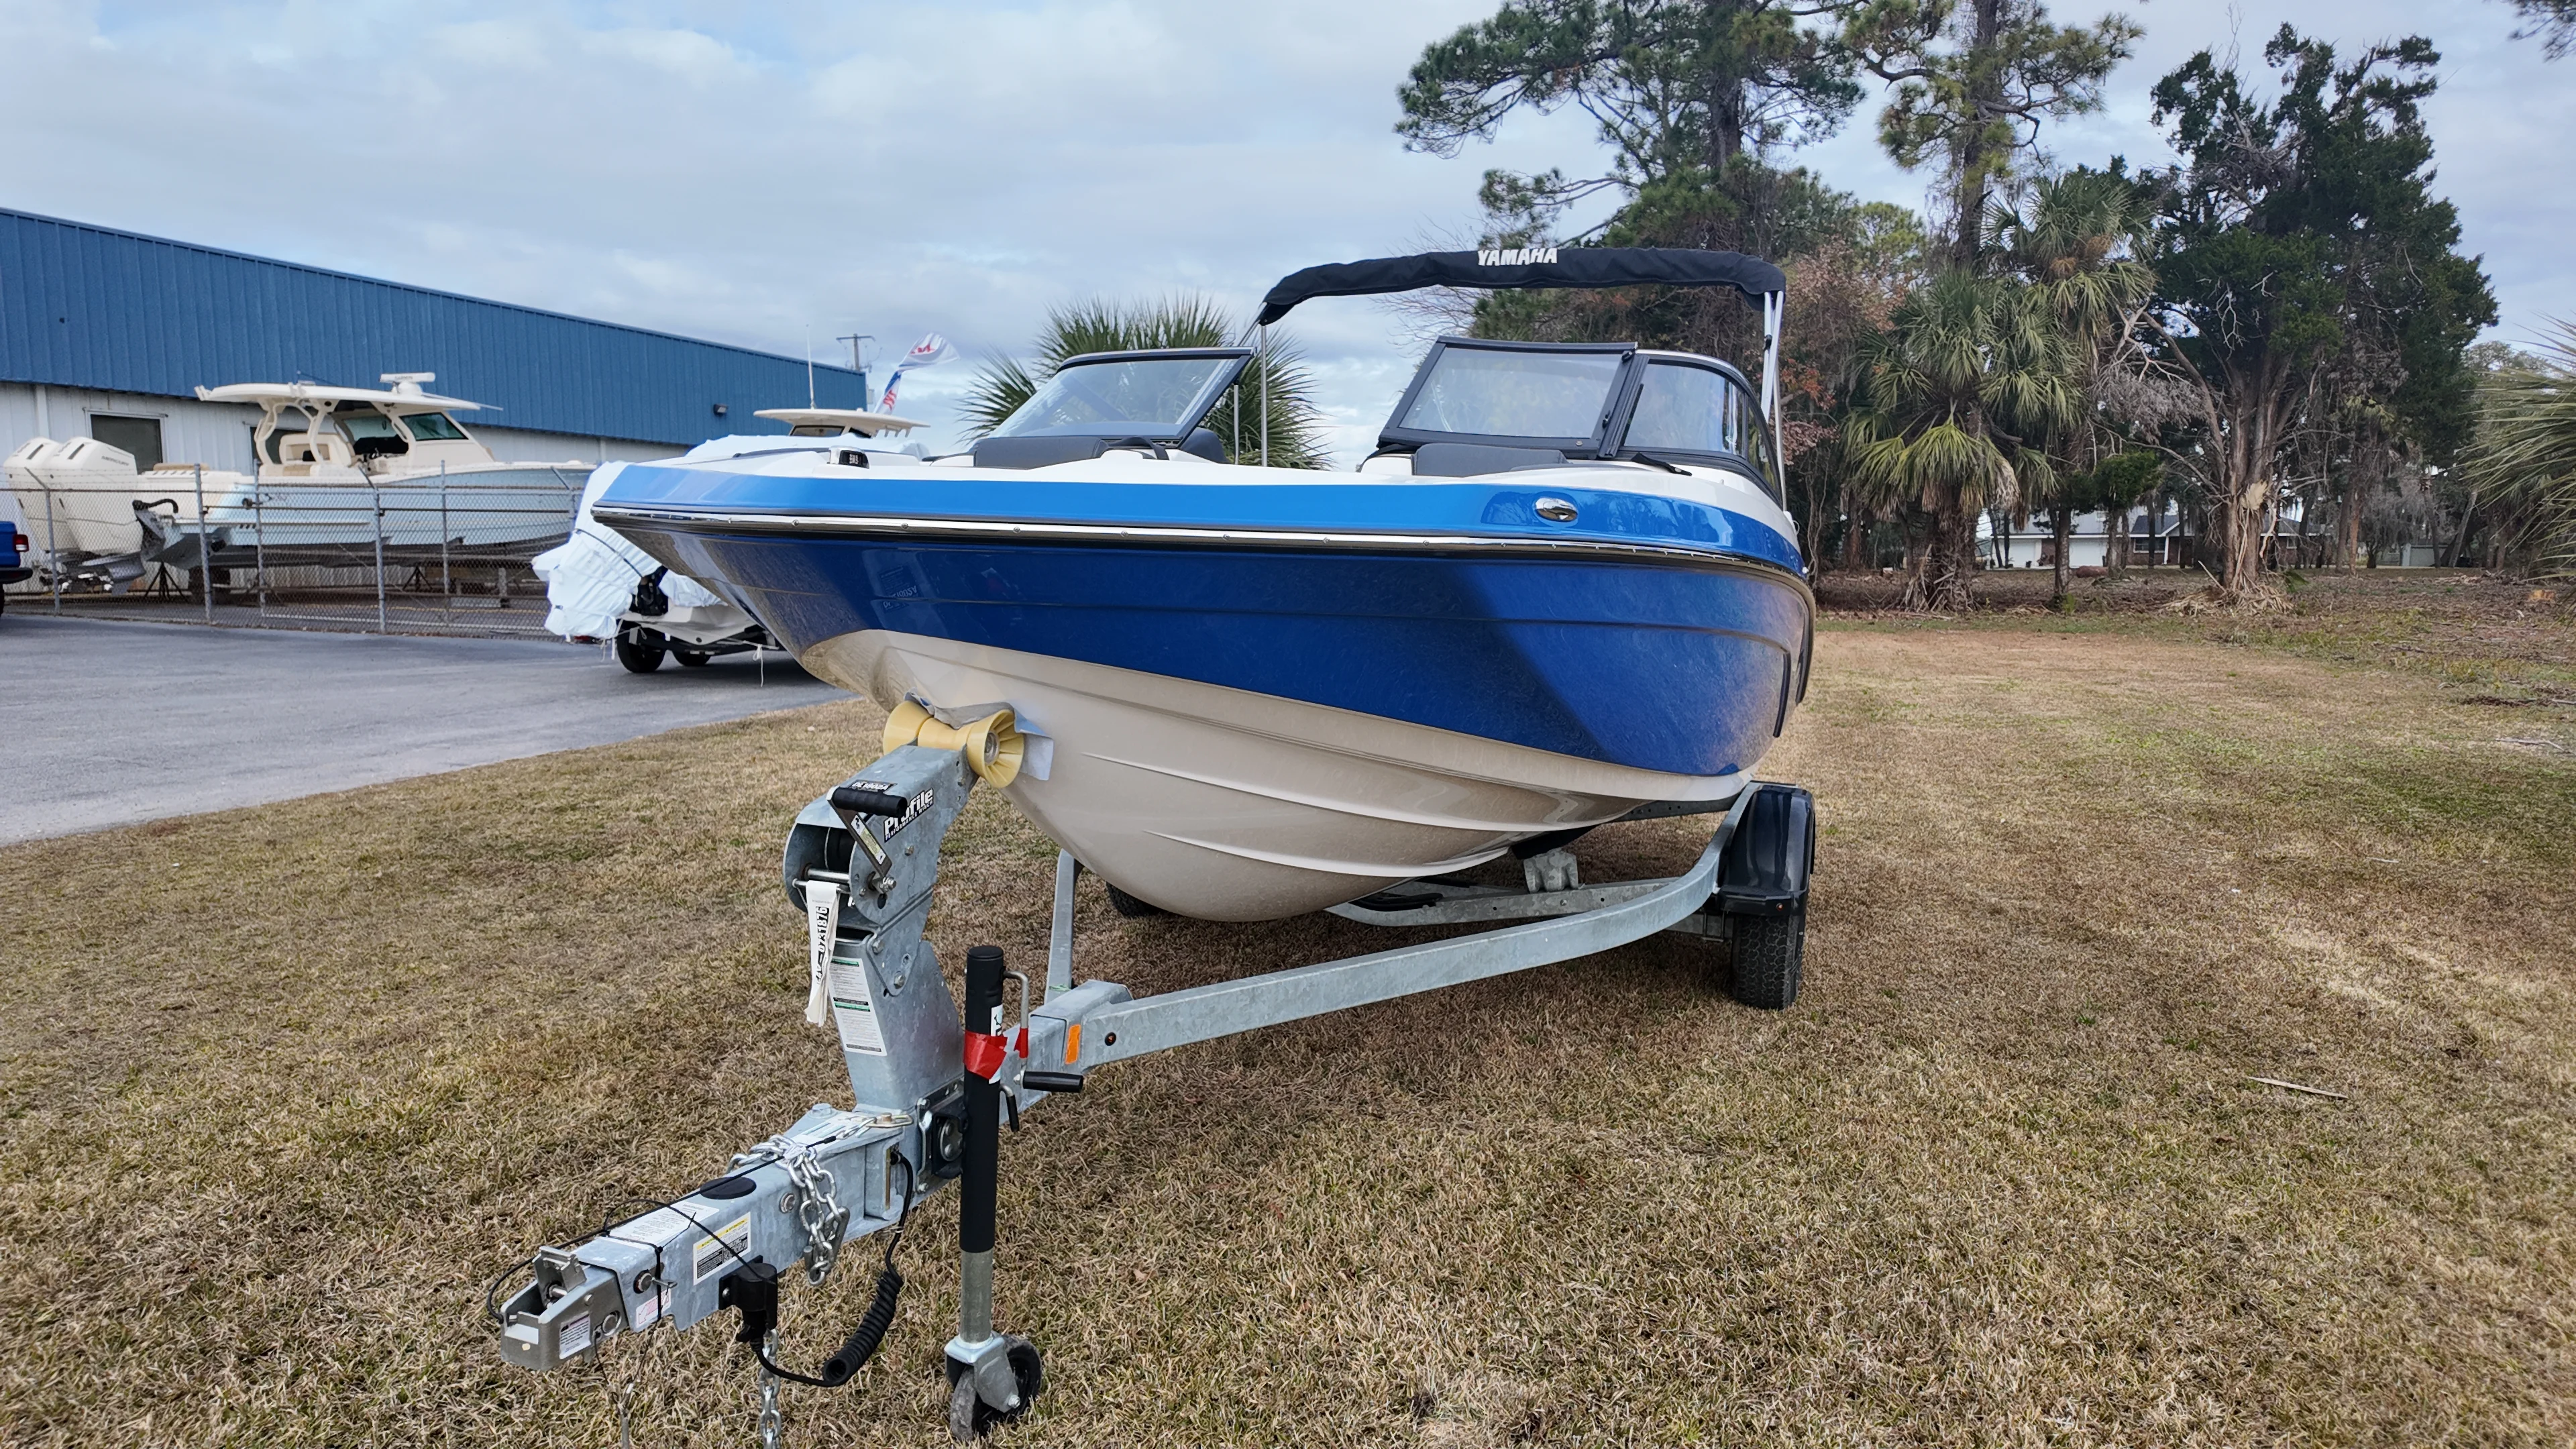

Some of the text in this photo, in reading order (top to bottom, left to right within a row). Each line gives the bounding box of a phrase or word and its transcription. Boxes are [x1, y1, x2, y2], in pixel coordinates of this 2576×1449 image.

[1478, 248, 1558, 266] YAMAHA
[885, 800, 933, 841] PERFORMANCE WINCH
